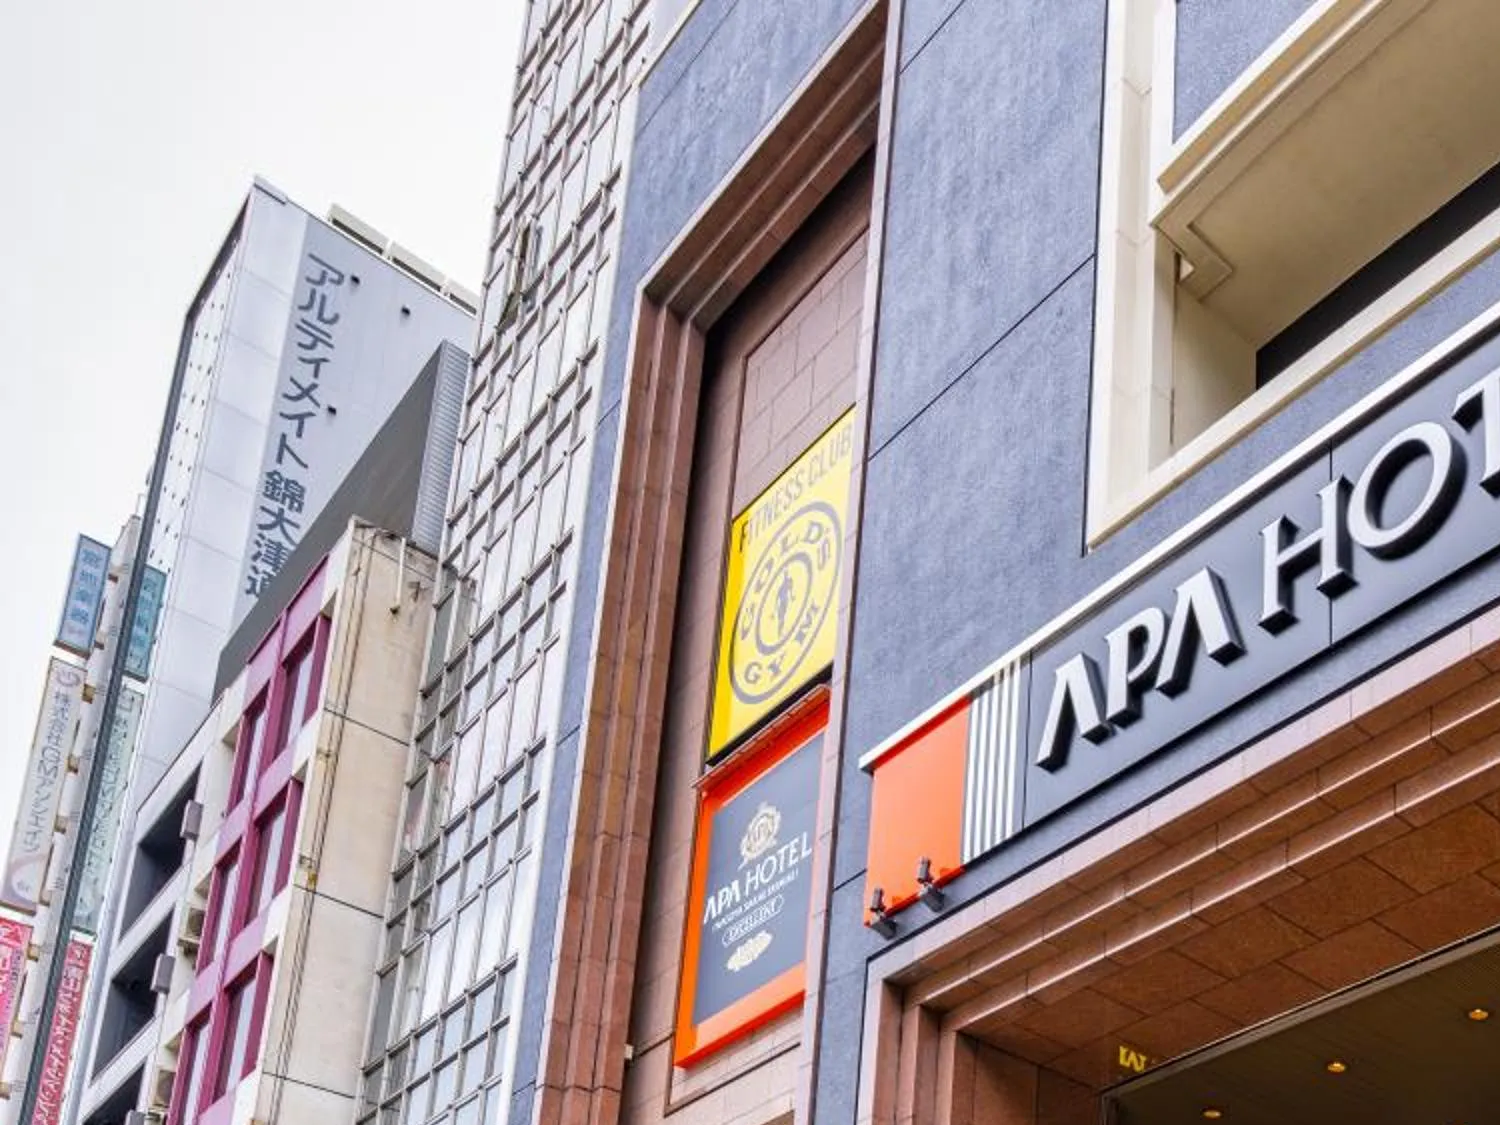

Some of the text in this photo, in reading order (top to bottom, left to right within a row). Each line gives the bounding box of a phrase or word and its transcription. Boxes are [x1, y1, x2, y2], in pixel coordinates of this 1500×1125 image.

[739, 427, 854, 552] FITNESS CLUB
[740, 518, 832, 641] GOLD'S
[743, 603, 820, 685] GYM
[1034, 565, 1247, 774] APA
[703, 831, 813, 925] APA HOTEL
